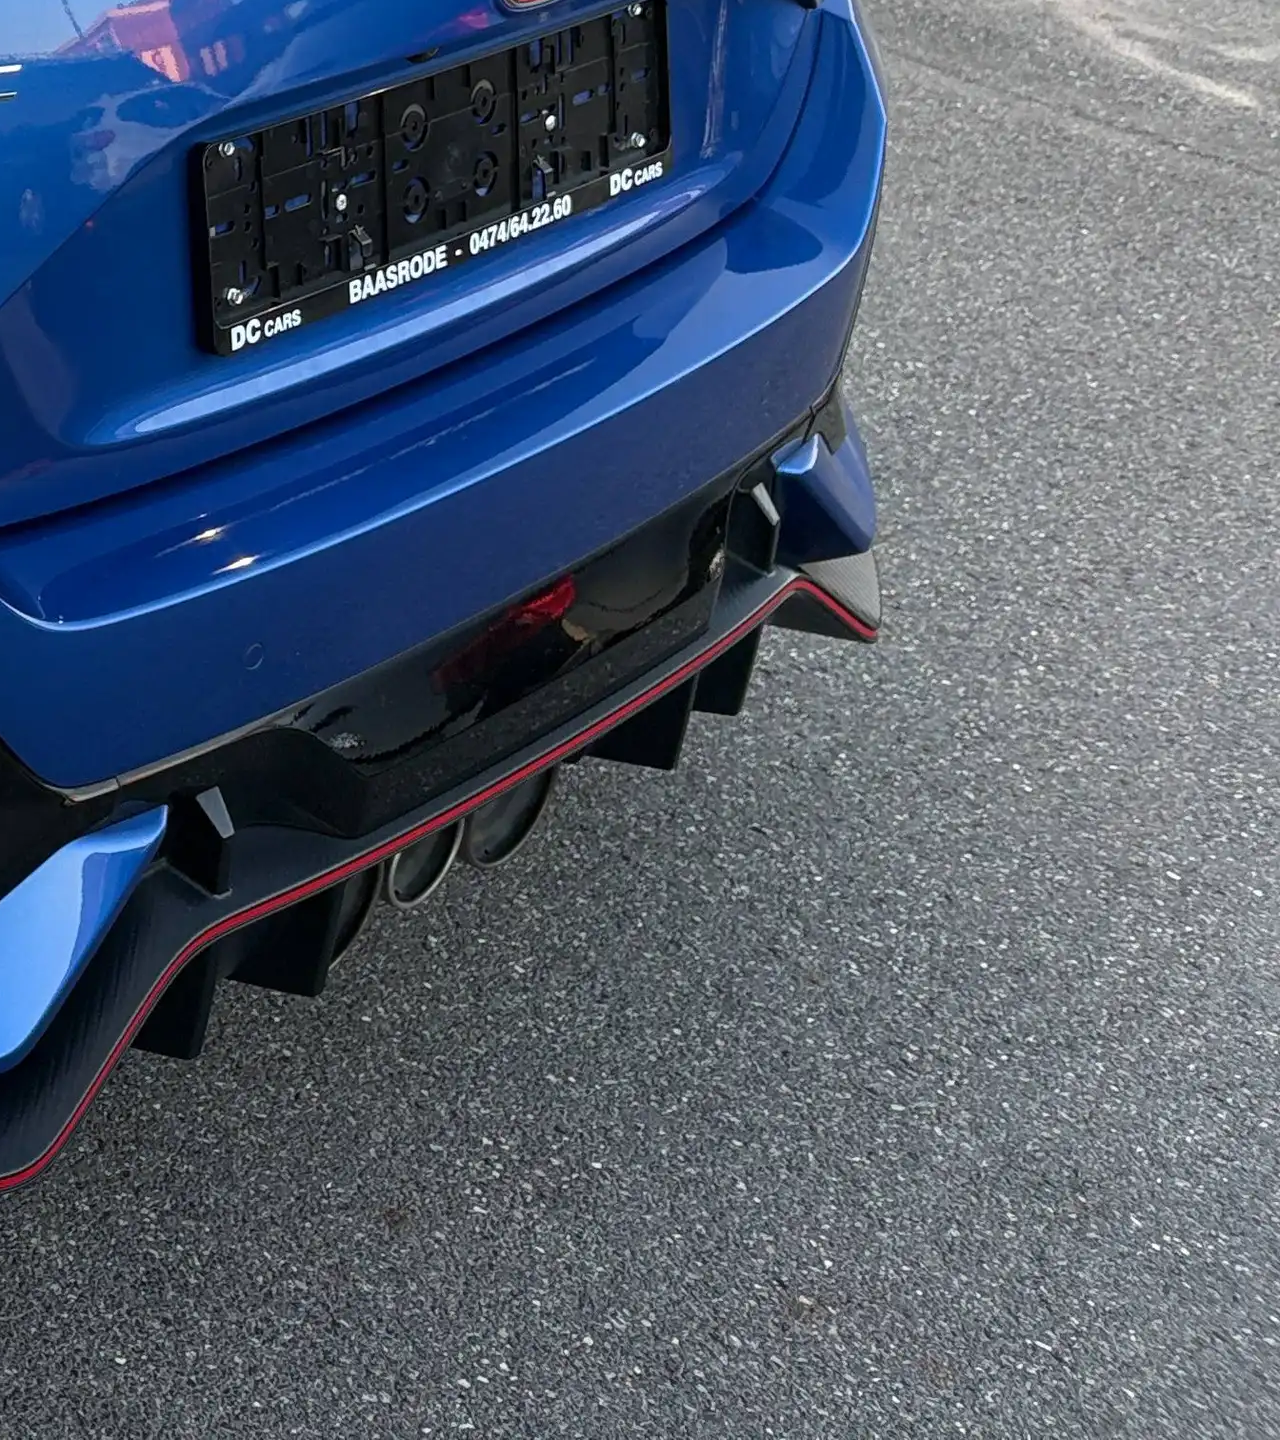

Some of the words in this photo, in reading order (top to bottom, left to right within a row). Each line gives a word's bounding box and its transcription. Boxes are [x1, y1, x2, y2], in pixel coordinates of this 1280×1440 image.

[230, 317, 262, 352] DC
[264, 308, 302, 339] CARS
[348, 245, 449, 305] BAASRODE
[469, 194, 572, 256] 0474/64.22.60
[609, 167, 634, 197] DC
[633, 160, 664, 186] CARS
